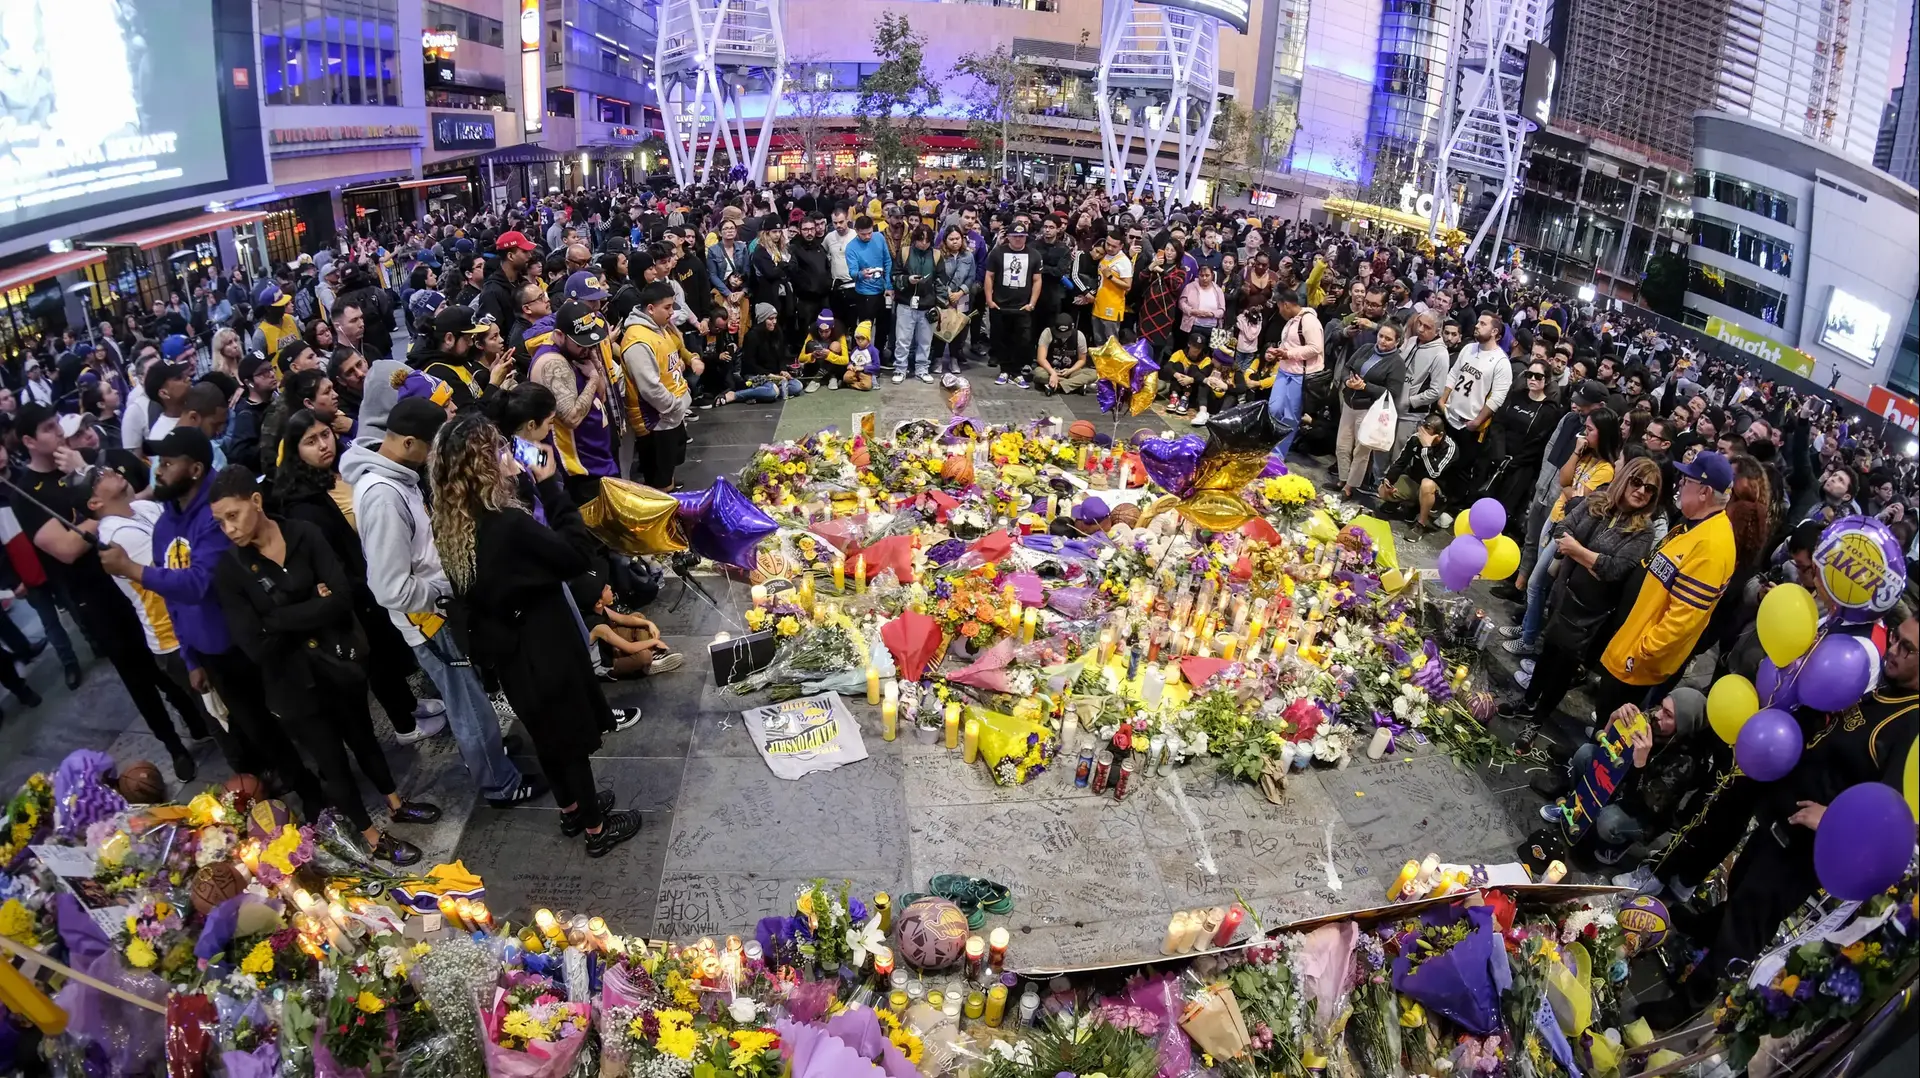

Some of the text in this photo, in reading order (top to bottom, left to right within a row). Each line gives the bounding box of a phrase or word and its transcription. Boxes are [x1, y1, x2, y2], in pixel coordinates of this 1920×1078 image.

[1460, 362, 1483, 381] LAKERS
[1454, 374, 1475, 398] 24
[1846, 545, 1863, 558] LOS
[1814, 537, 1901, 608] LAKERS
[768, 720, 839, 754] CHAMPIONSHIP
[1186, 873, 1214, 893] RIP
[1294, 871, 1319, 881] Love
[1294, 880, 1304, 889] U
[657, 904, 710, 922] KOBE
[1621, 910, 1657, 930] LAKERS
[657, 922, 726, 936] THANK YOU
